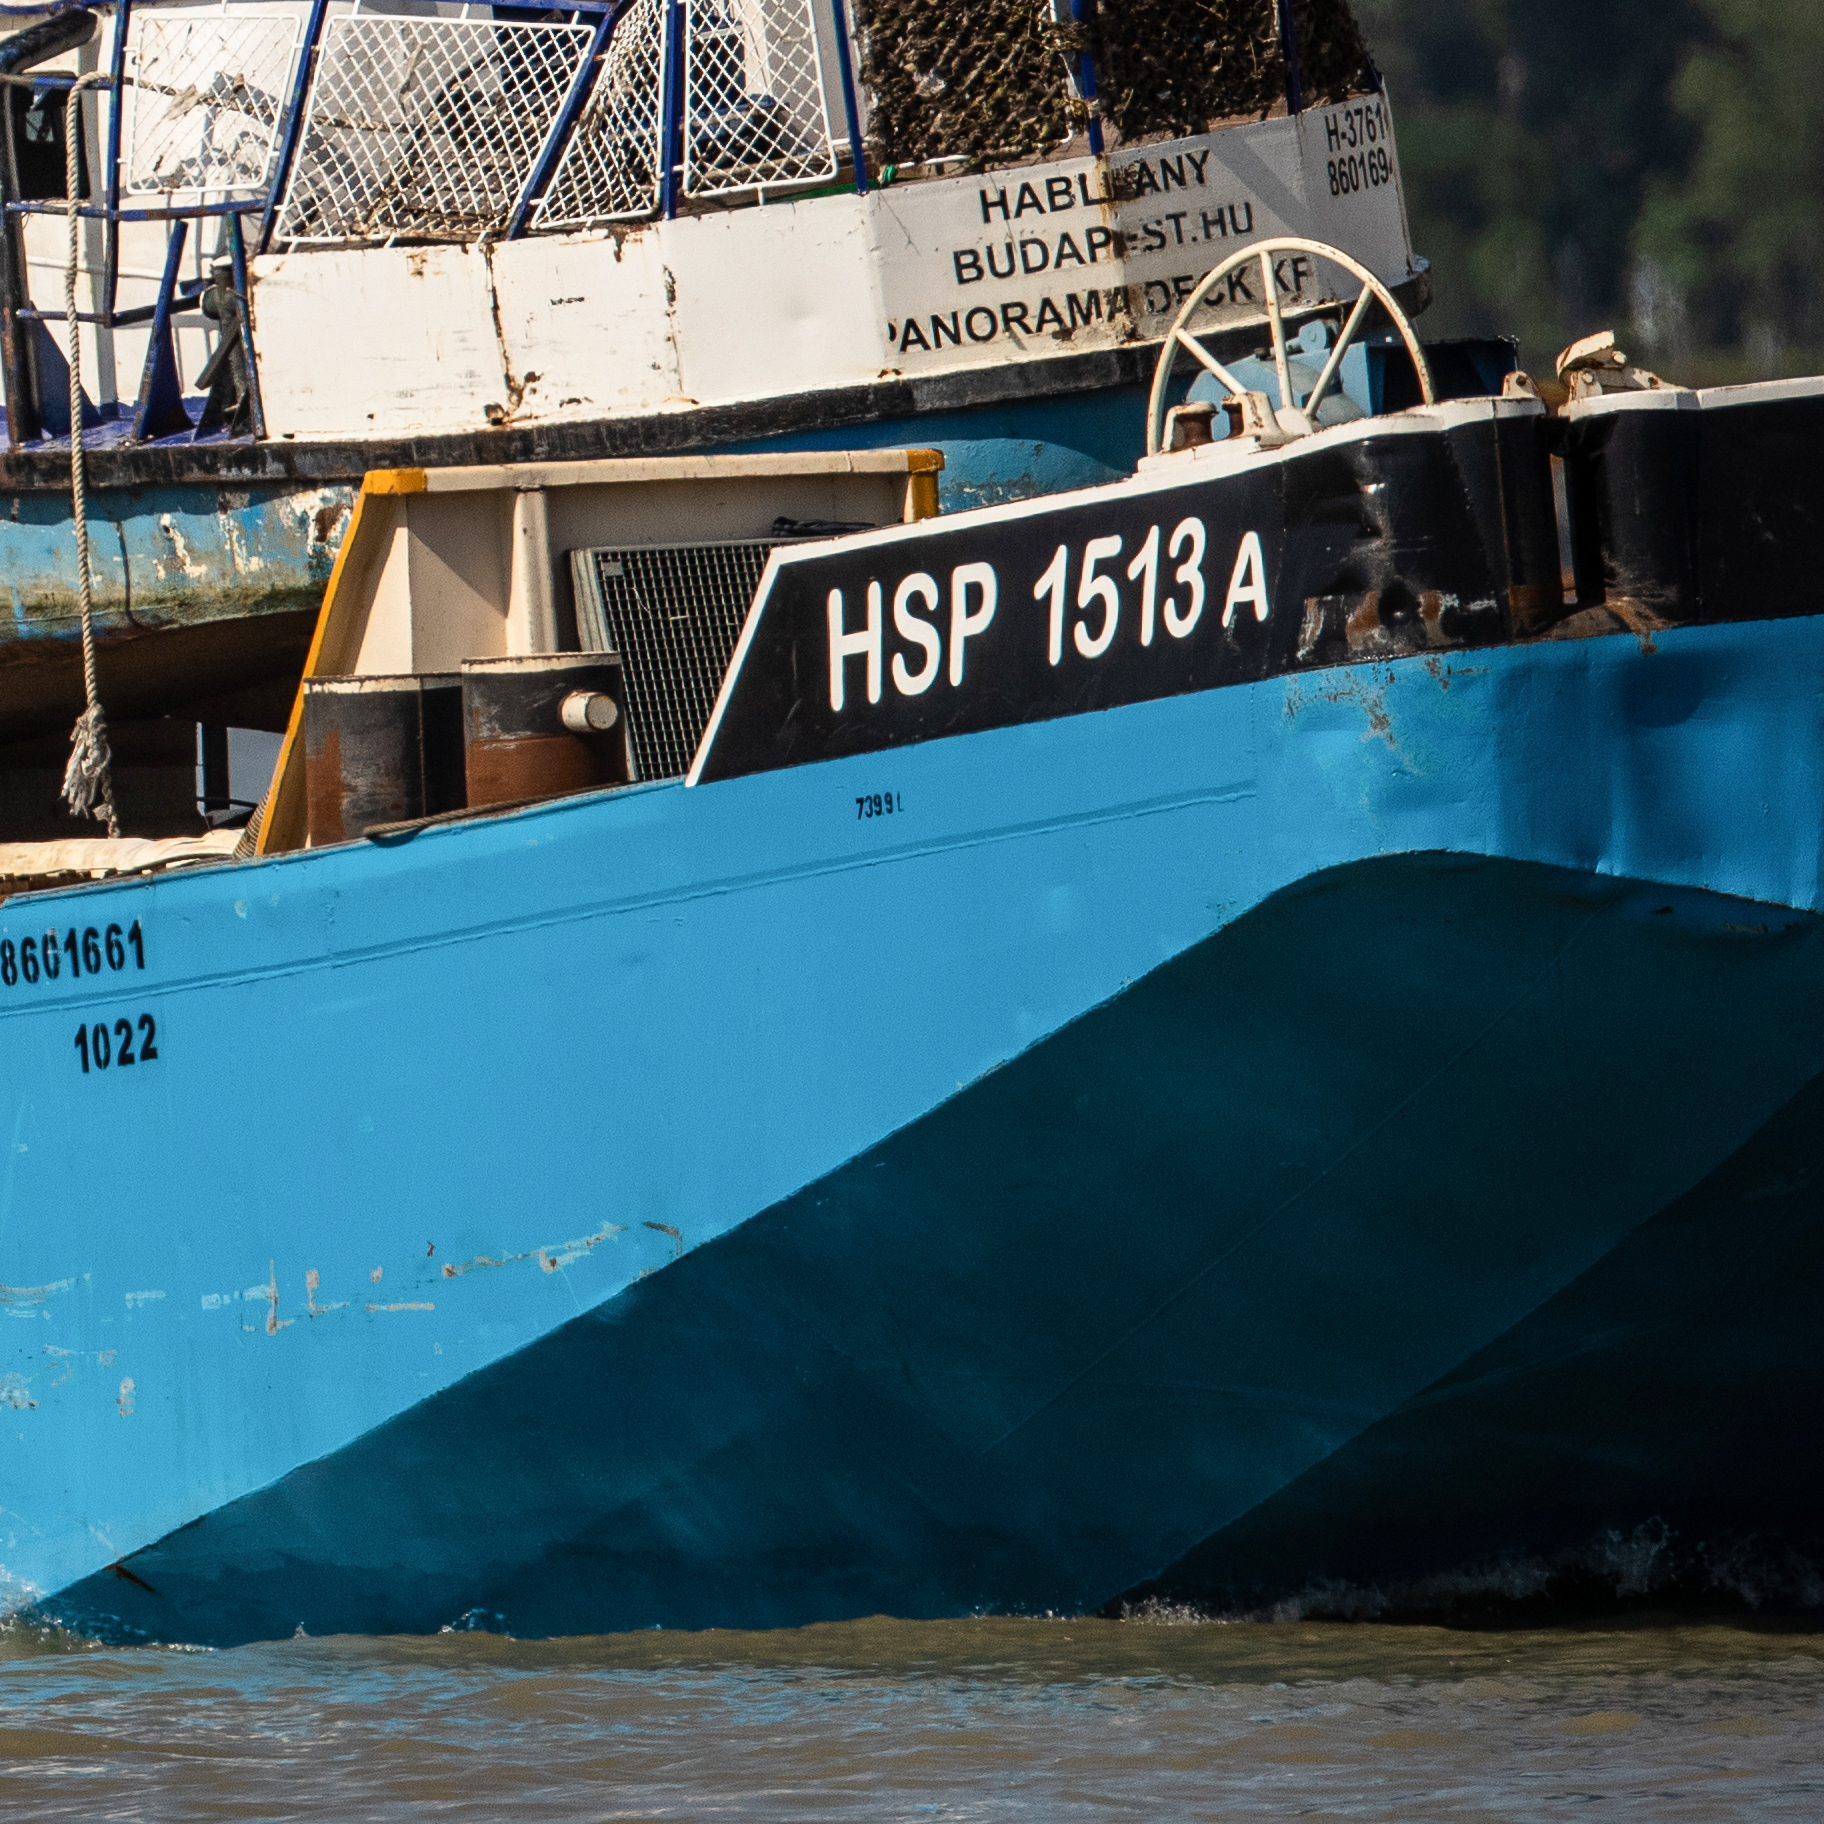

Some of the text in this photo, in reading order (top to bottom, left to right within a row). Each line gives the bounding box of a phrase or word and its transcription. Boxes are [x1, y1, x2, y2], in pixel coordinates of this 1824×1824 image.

[1328, 147, 1393, 196] 860169
[888, 285, 1131, 355] ANORAMA
[826, 516, 1270, 712] HSP 1513 A
[74, 1013, 158, 1073] 1022
